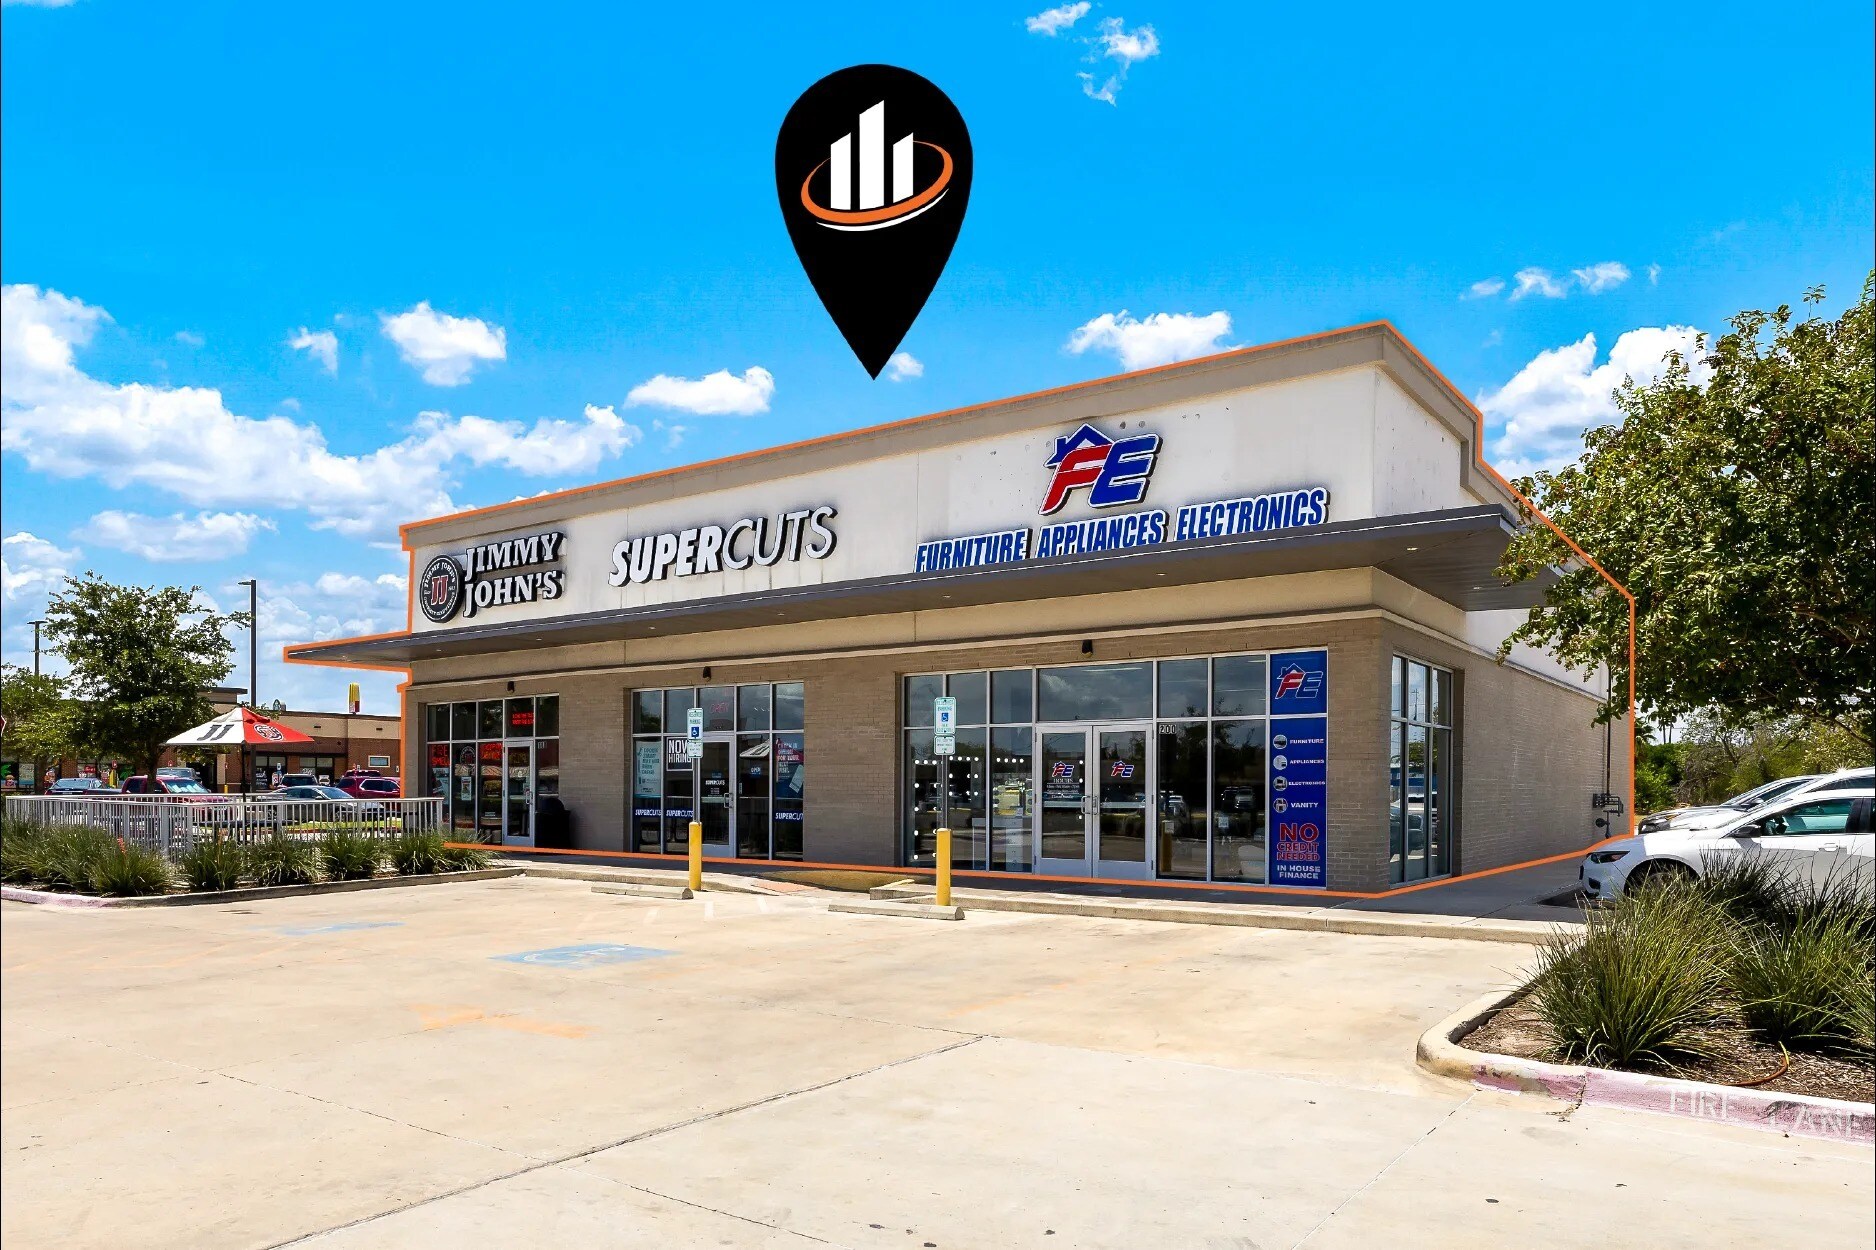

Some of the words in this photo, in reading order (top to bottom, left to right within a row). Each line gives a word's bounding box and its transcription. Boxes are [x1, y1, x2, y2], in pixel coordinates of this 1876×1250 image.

[1039, 433, 1163, 516] FE
[914, 529, 1032, 573] FURNITURE
[1036, 510, 1169, 559] APPLIANCES
[1176, 487, 1330, 542] ELECTRONICS
[465, 533, 563, 581] JIMMY
[608, 505, 838, 588] SUPERCUTS
[431, 575, 449, 606] JJ
[463, 569, 563, 618] JOHN'S
[1275, 670, 1323, 700] FE
[197, 724, 234, 741] JJ
[1159, 724, 1177, 735] 200
[1277, 842, 1319, 852] CREDIT
[1280, 823, 1319, 842] NO
[1277, 851, 1320, 861] NEEDED
[1277, 864, 1287, 872] IN
[1279, 872, 1319, 880] FINANCE
[1670, 1089, 1728, 1119] FIRE
